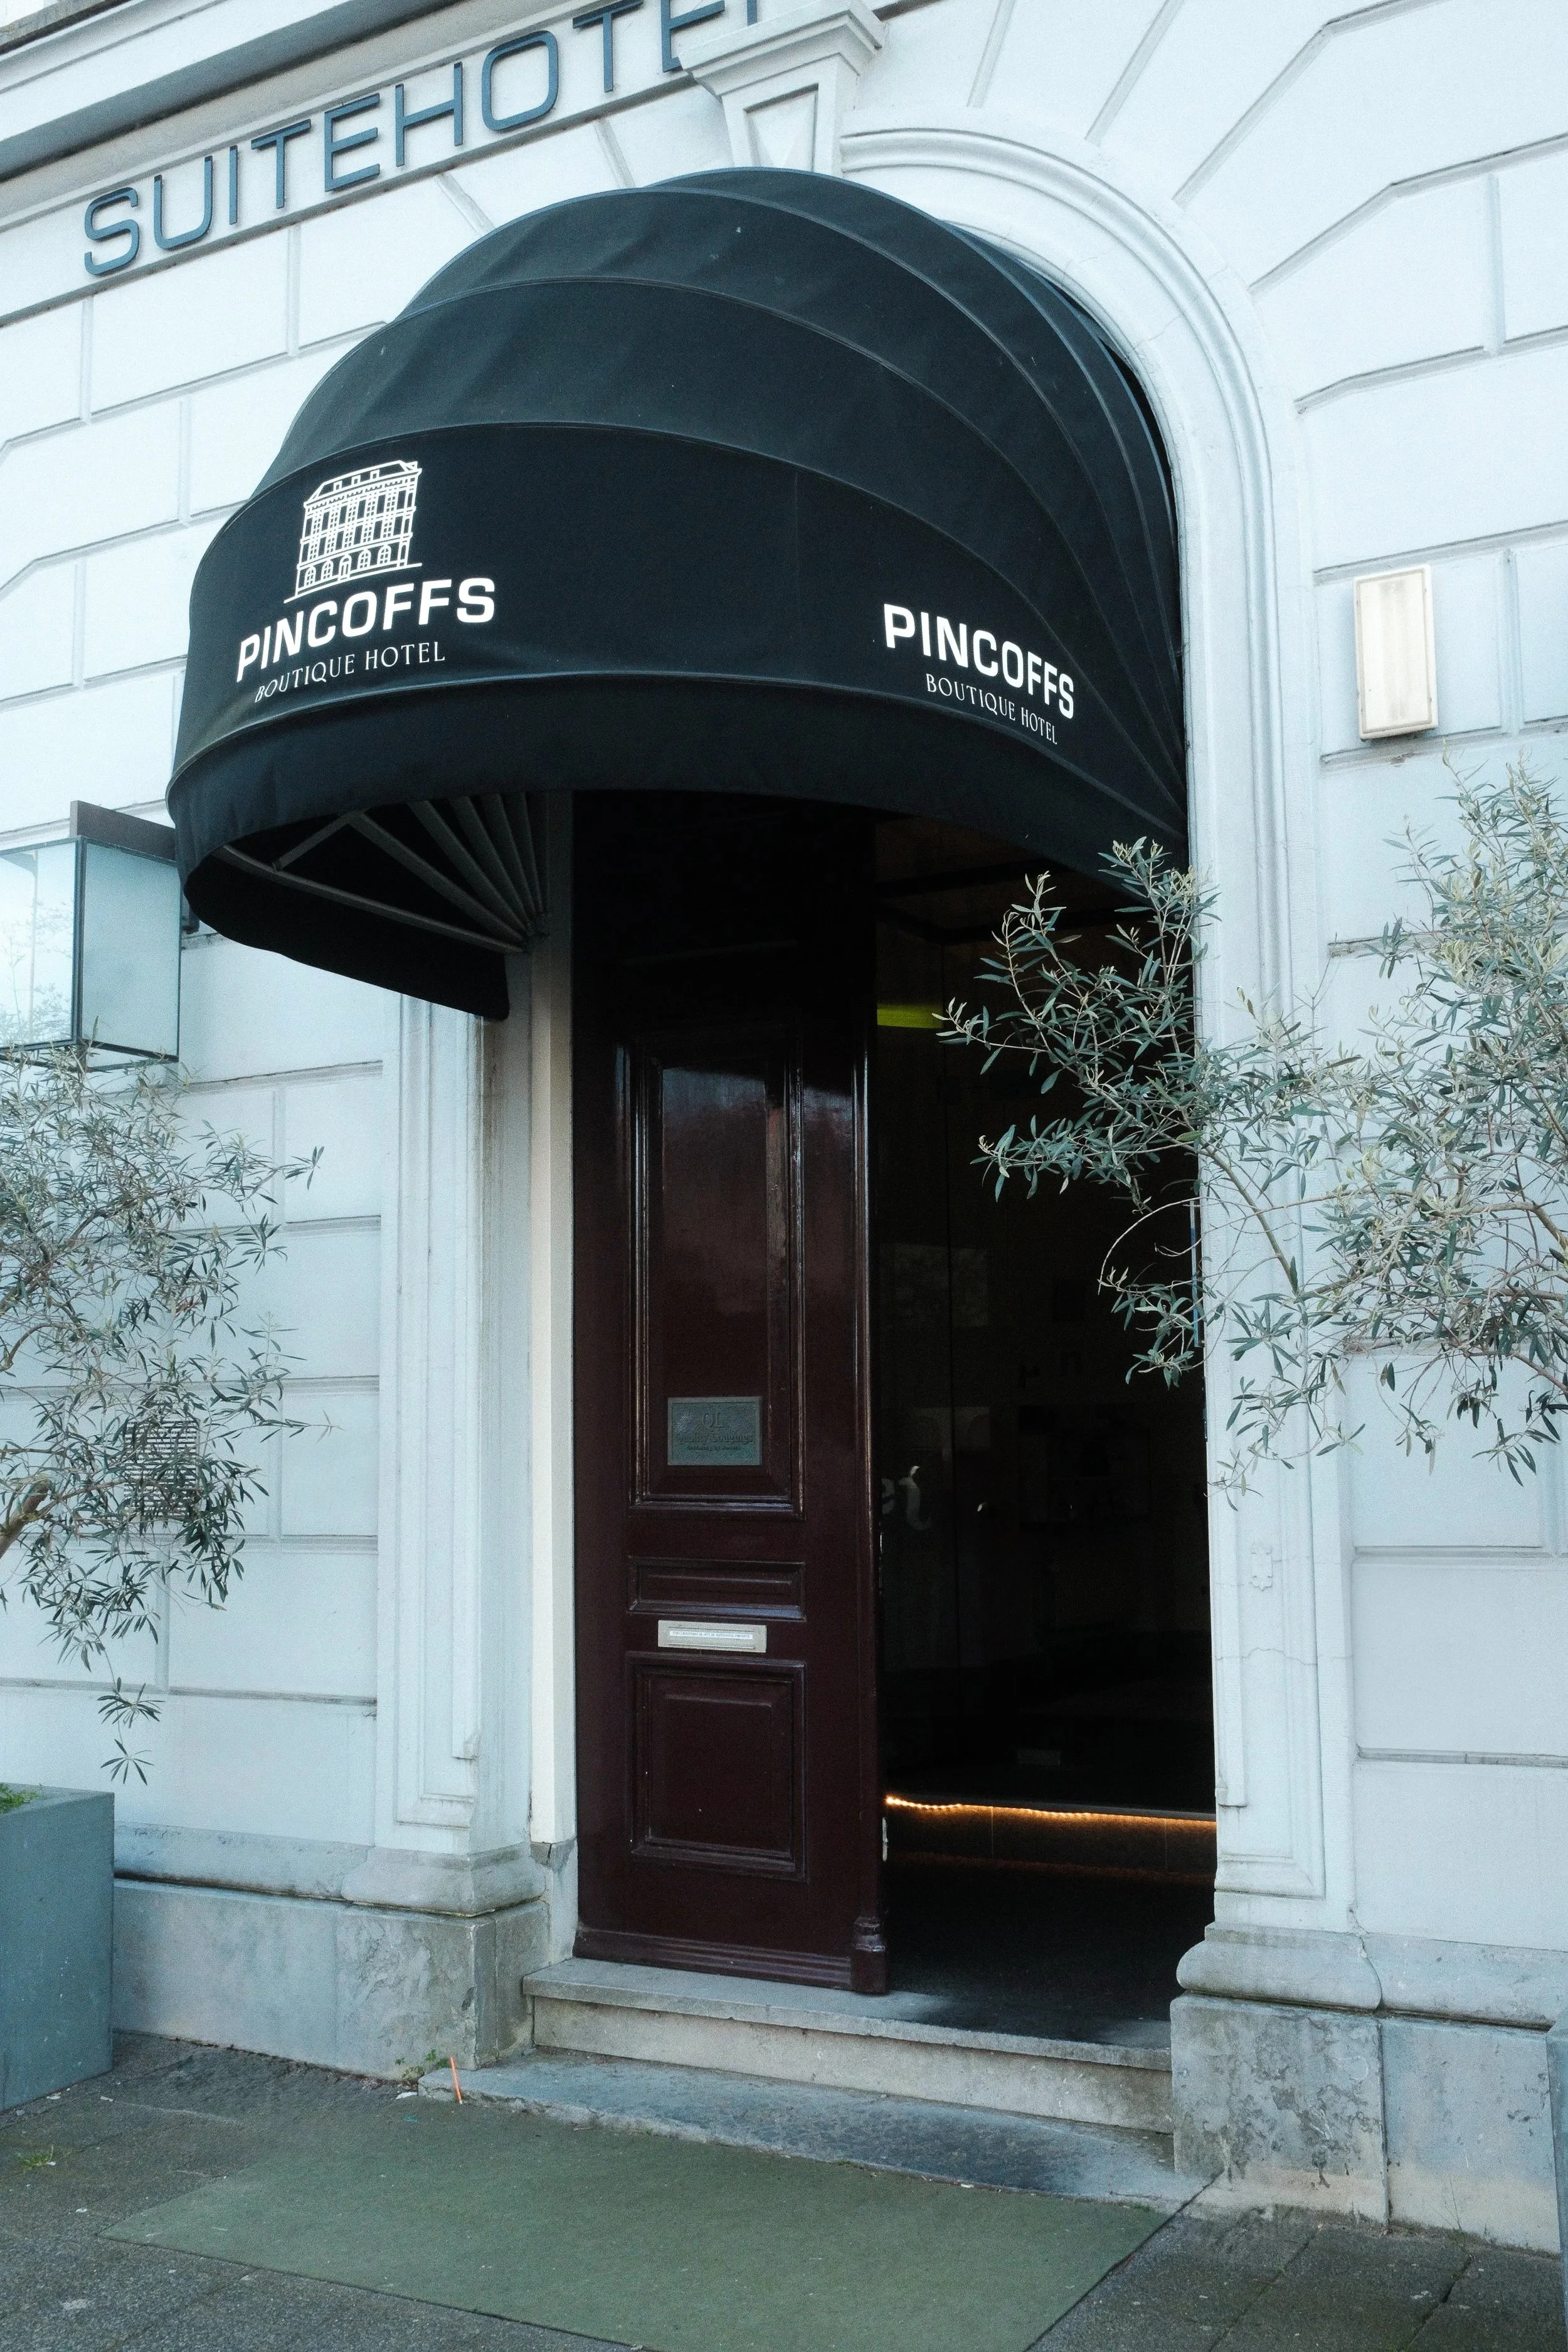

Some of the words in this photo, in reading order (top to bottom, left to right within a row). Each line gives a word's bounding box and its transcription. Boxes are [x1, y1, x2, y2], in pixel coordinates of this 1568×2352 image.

[236, 577, 495, 683] PINCOFFS
[254, 654, 356, 702] BOUTIQUE
[365, 642, 445, 670] HOTEL
[884, 603, 1074, 719] PINCOFFS
[926, 673, 1015, 721] BOUTIQUE
[1020, 706, 1057, 745] HOTEL
